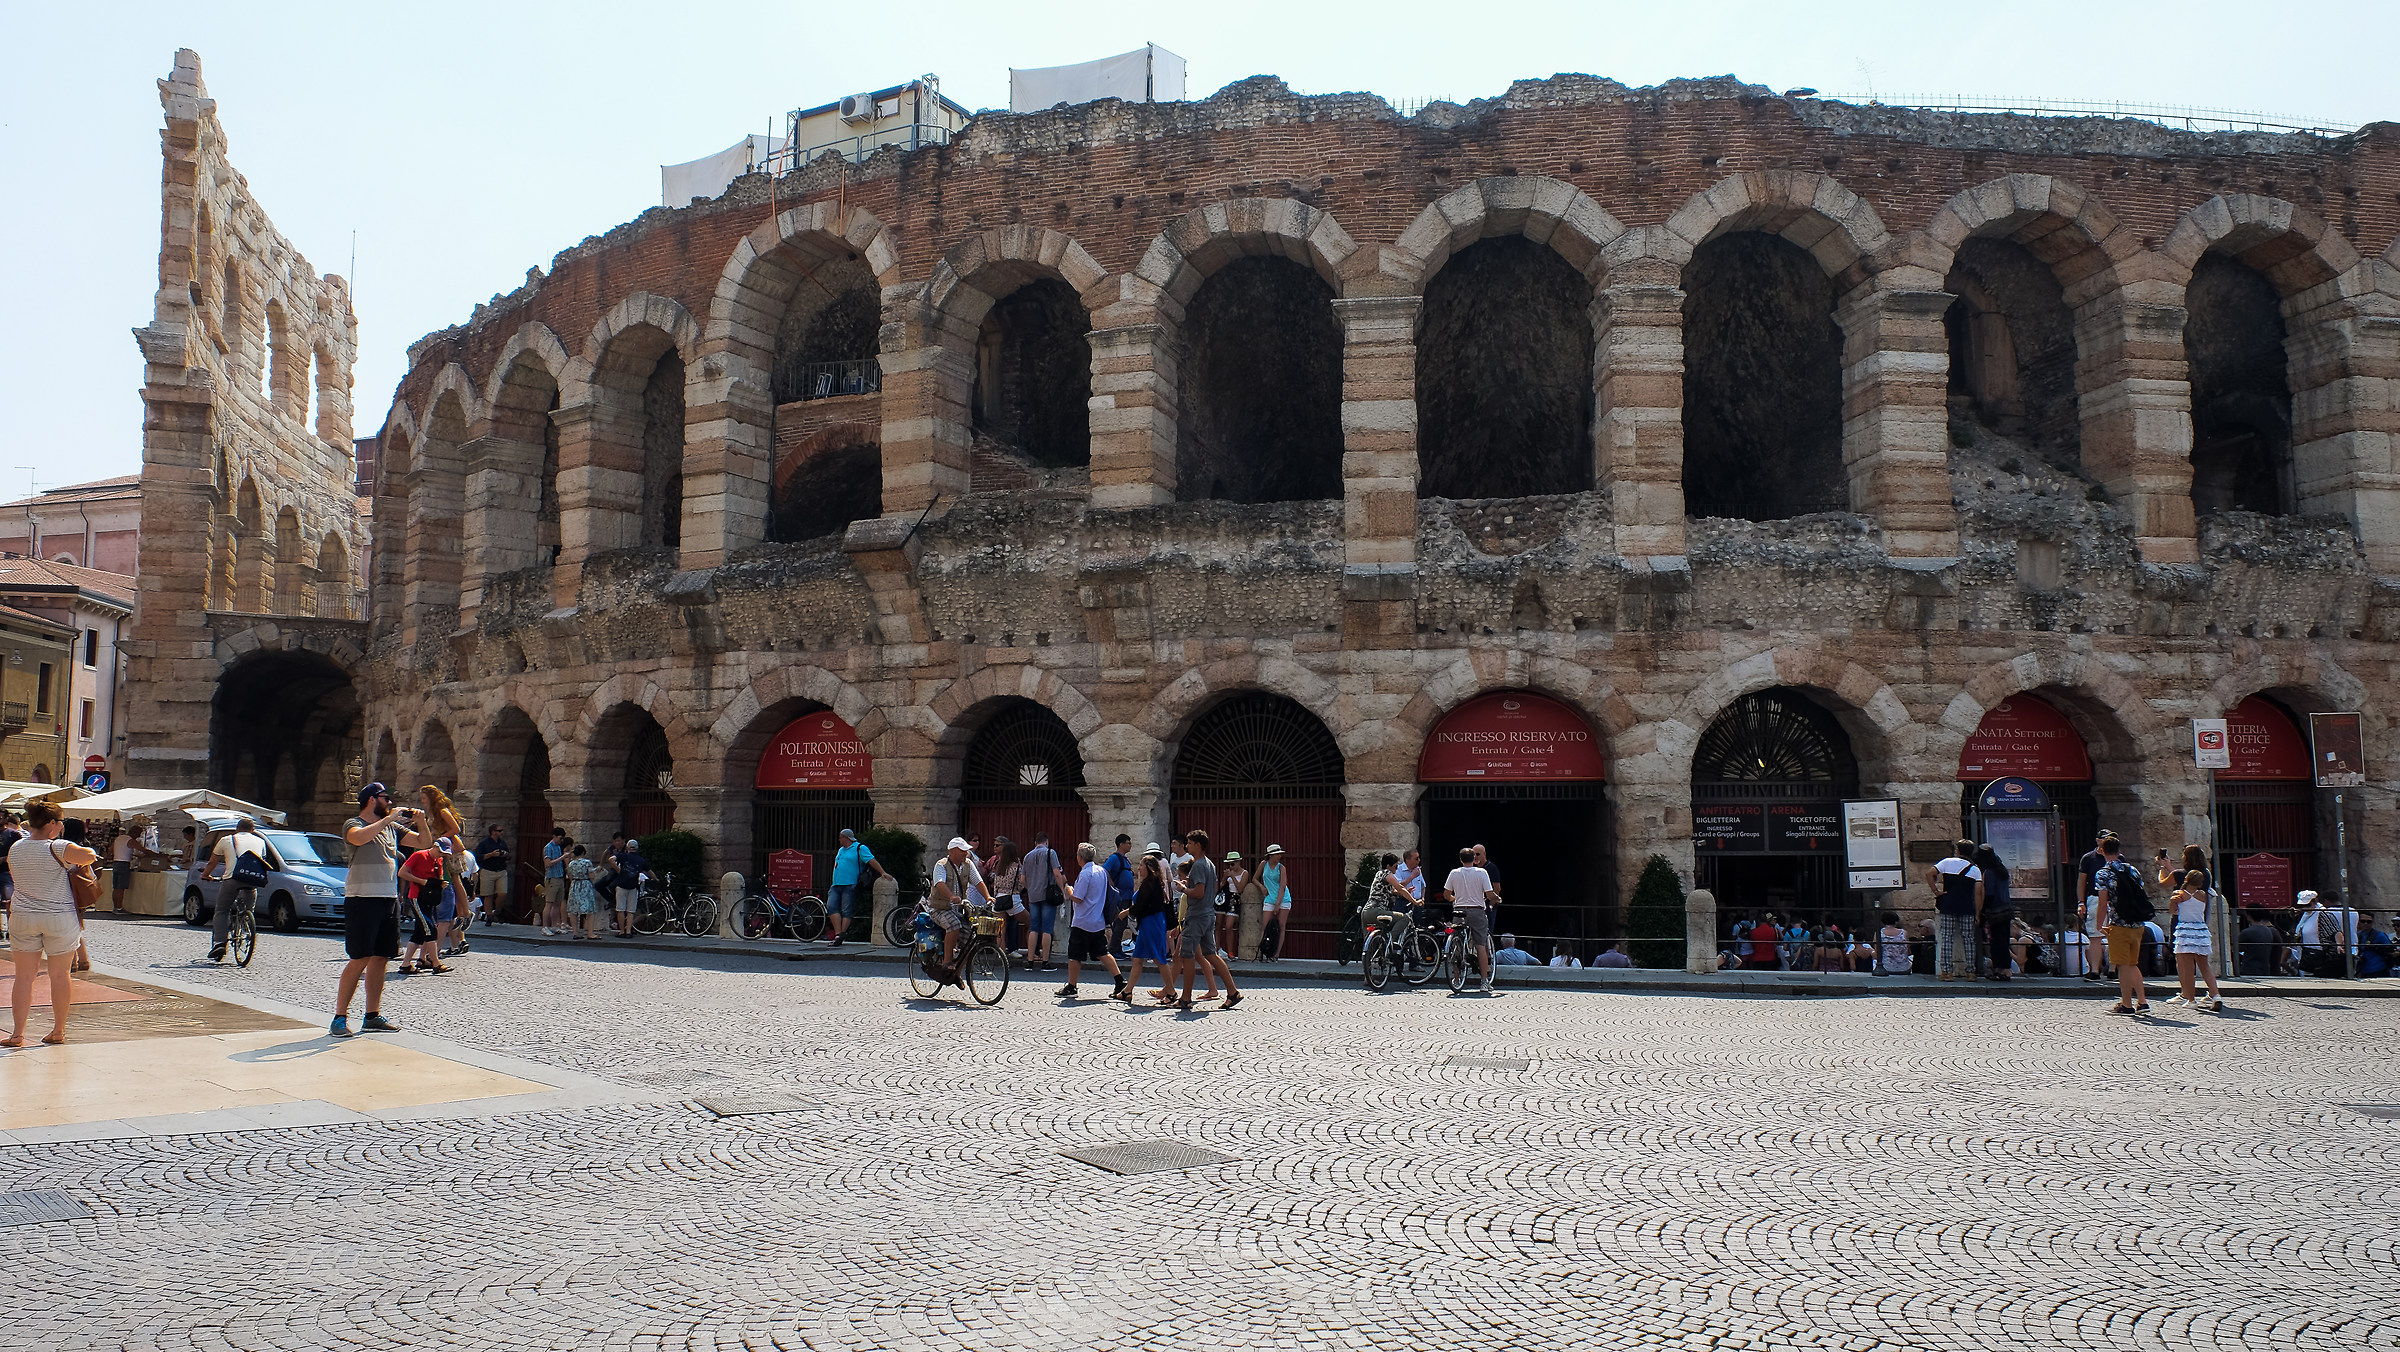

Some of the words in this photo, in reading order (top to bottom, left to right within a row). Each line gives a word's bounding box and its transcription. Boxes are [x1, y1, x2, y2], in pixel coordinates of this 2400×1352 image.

[1438, 732, 1506, 743] INGRESSO
[1509, 731, 1588, 742] RISERVATO
[2233, 734, 2271, 744] OFFICE
[1472, 746, 1509, 755] Entrata
[1520, 746, 1545, 754] Gate
[1546, 744, 1554, 754] 4
[1971, 743, 2002, 751] Entrata
[2011, 743, 2032, 751] Gate
[2033, 743, 2040, 751] 6
[2241, 746, 2260, 754] Gate
[2261, 746, 2267, 754] 7
[790, 759, 824, 768] Entrata
[834, 758, 857, 767] Gate
[1699, 806, 1761, 815] ANFITEATRO
[1771, 806, 1805, 814] ARENA
[1717, 831, 1736, 839] Gruppi
